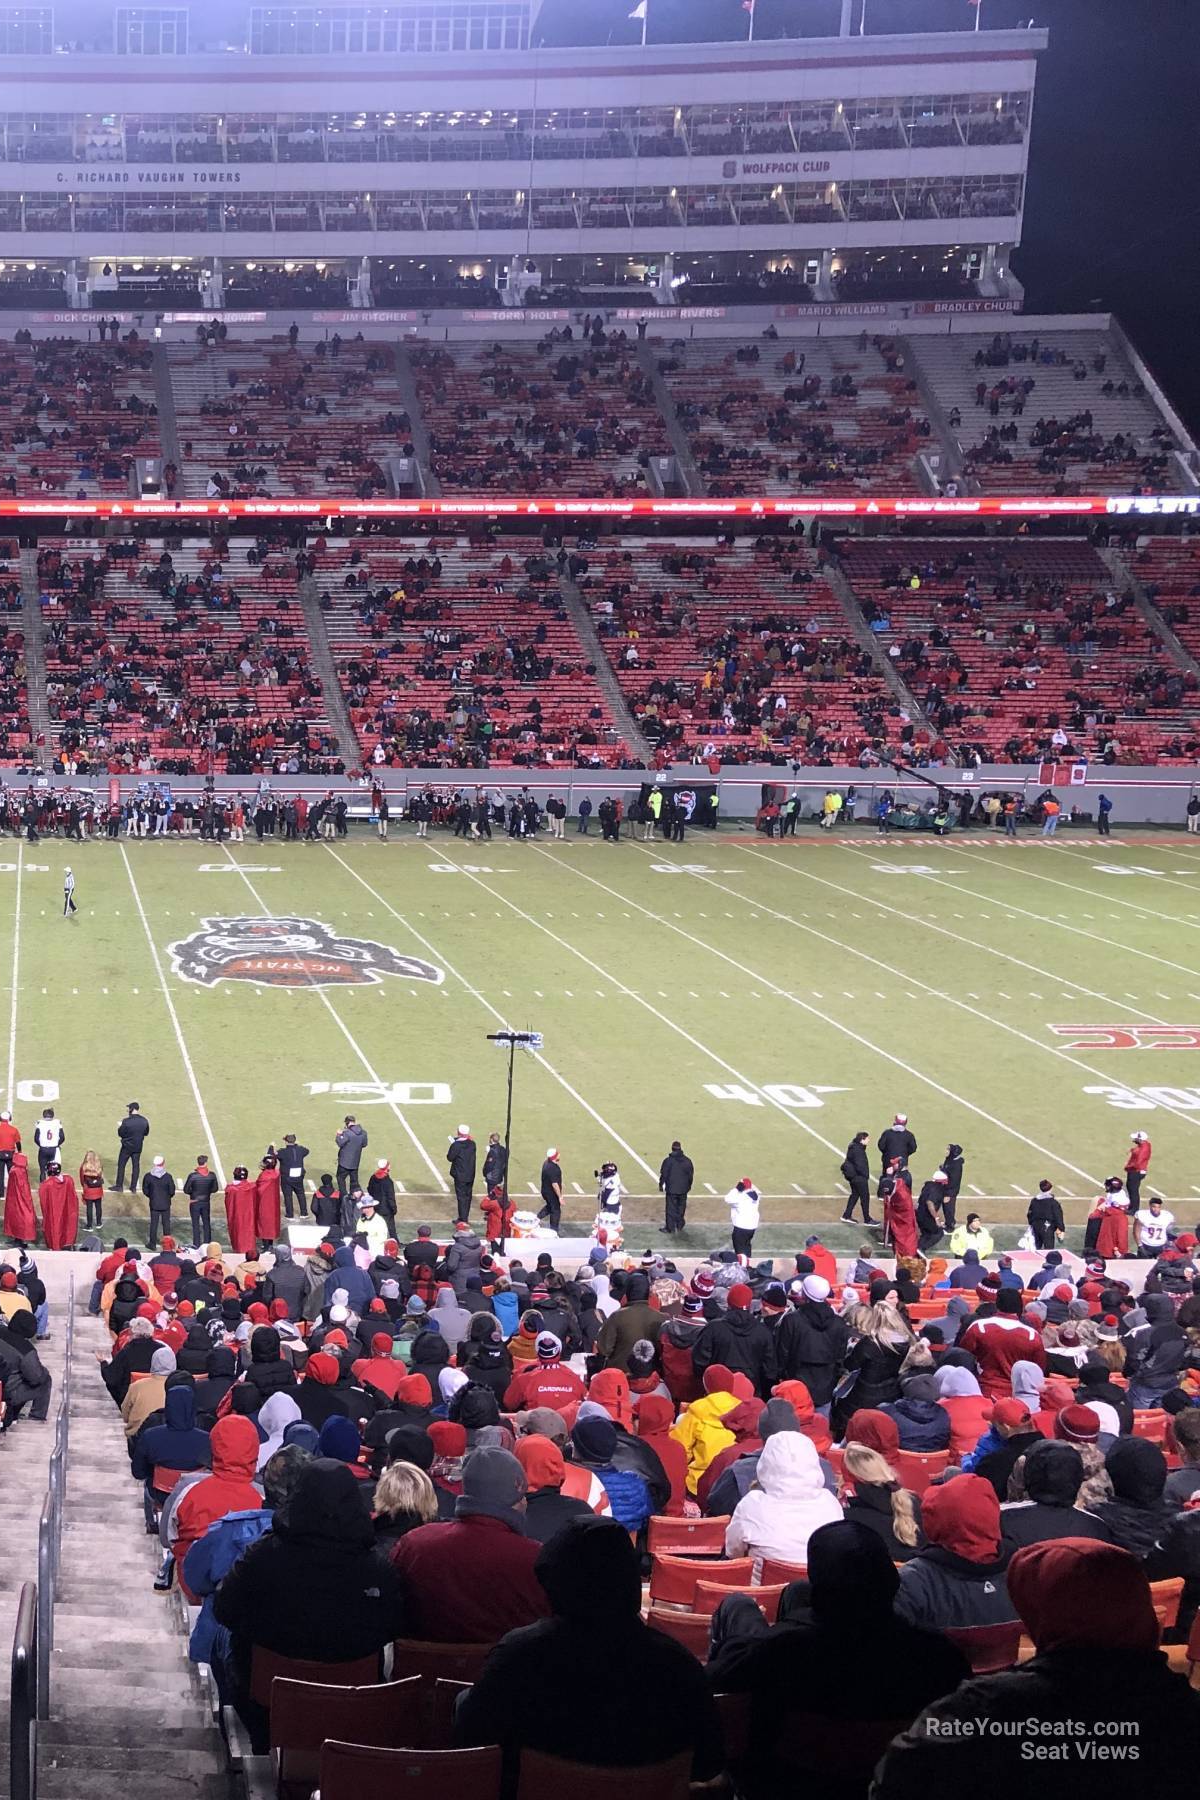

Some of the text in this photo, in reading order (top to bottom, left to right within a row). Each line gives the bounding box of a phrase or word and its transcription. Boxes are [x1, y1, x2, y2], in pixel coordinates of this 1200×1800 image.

[742, 160, 830, 174] WOLFPACK CLUB
[77, 172, 129, 182] RICHARD
[138, 172, 184, 182] VAUGHN
[193, 172, 241, 182] TOWERS
[798, 304, 886, 315] MARIO WILLIAMS
[934, 301, 1020, 312] BRADLEY CHUBB
[54, 313, 79, 322] DICK
[341, 312, 359, 321] JIM
[530, 311, 558, 320] HOLT
[641, 308, 720, 318] PHILIP RIVERS
[655, 773, 667, 782] 22
[962, 773, 974, 782] 23
[37, 779, 48, 788] 20
[702, 1083, 826, 1107] 40
[1081, 1086, 1200, 1109] 30
[46, 1129, 53, 1140] 6
[537, 1385, 573, 1393] CARDINALS
